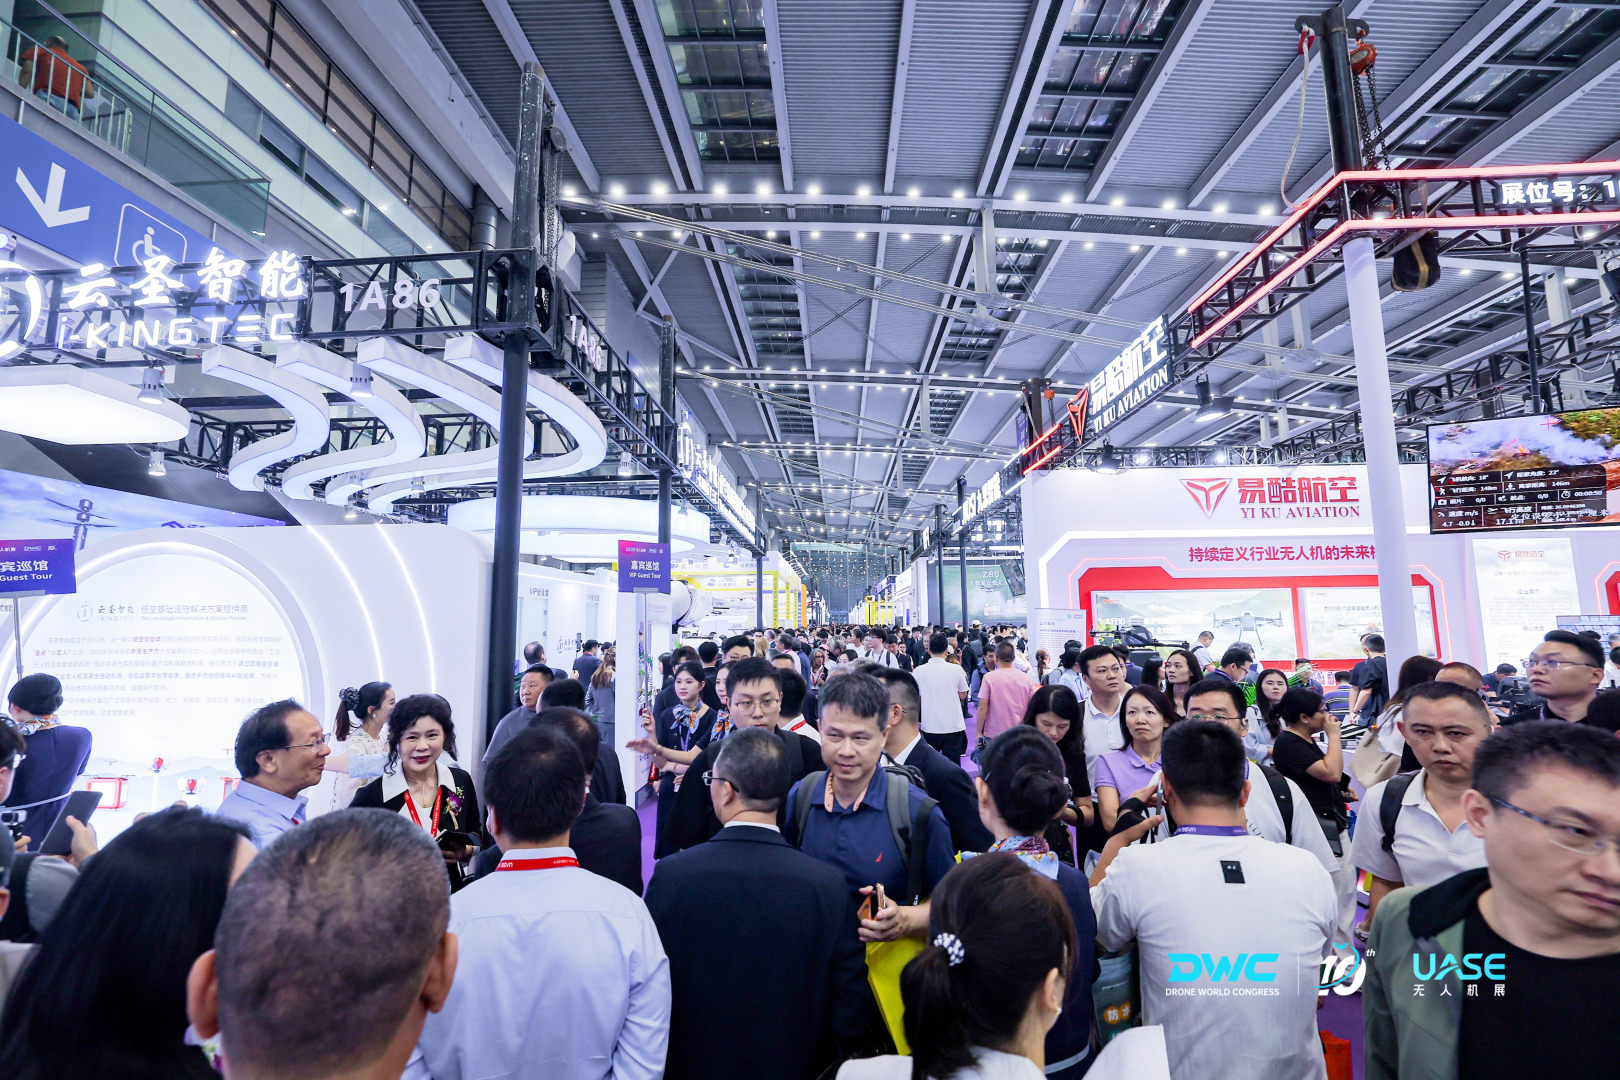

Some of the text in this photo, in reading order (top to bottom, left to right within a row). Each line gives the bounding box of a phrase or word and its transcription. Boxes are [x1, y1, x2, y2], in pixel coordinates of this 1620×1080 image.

[63, 246, 304, 309] 云圣智能
[340, 279, 440, 312] 1A86
[1090, 314, 1168, 416] 易酷航空
[1094, 364, 1169, 434] YI KU AVIATION
[1238, 476, 1360, 504] 易酷航空
[1241, 506, 1361, 519] YI KU AVIATION
